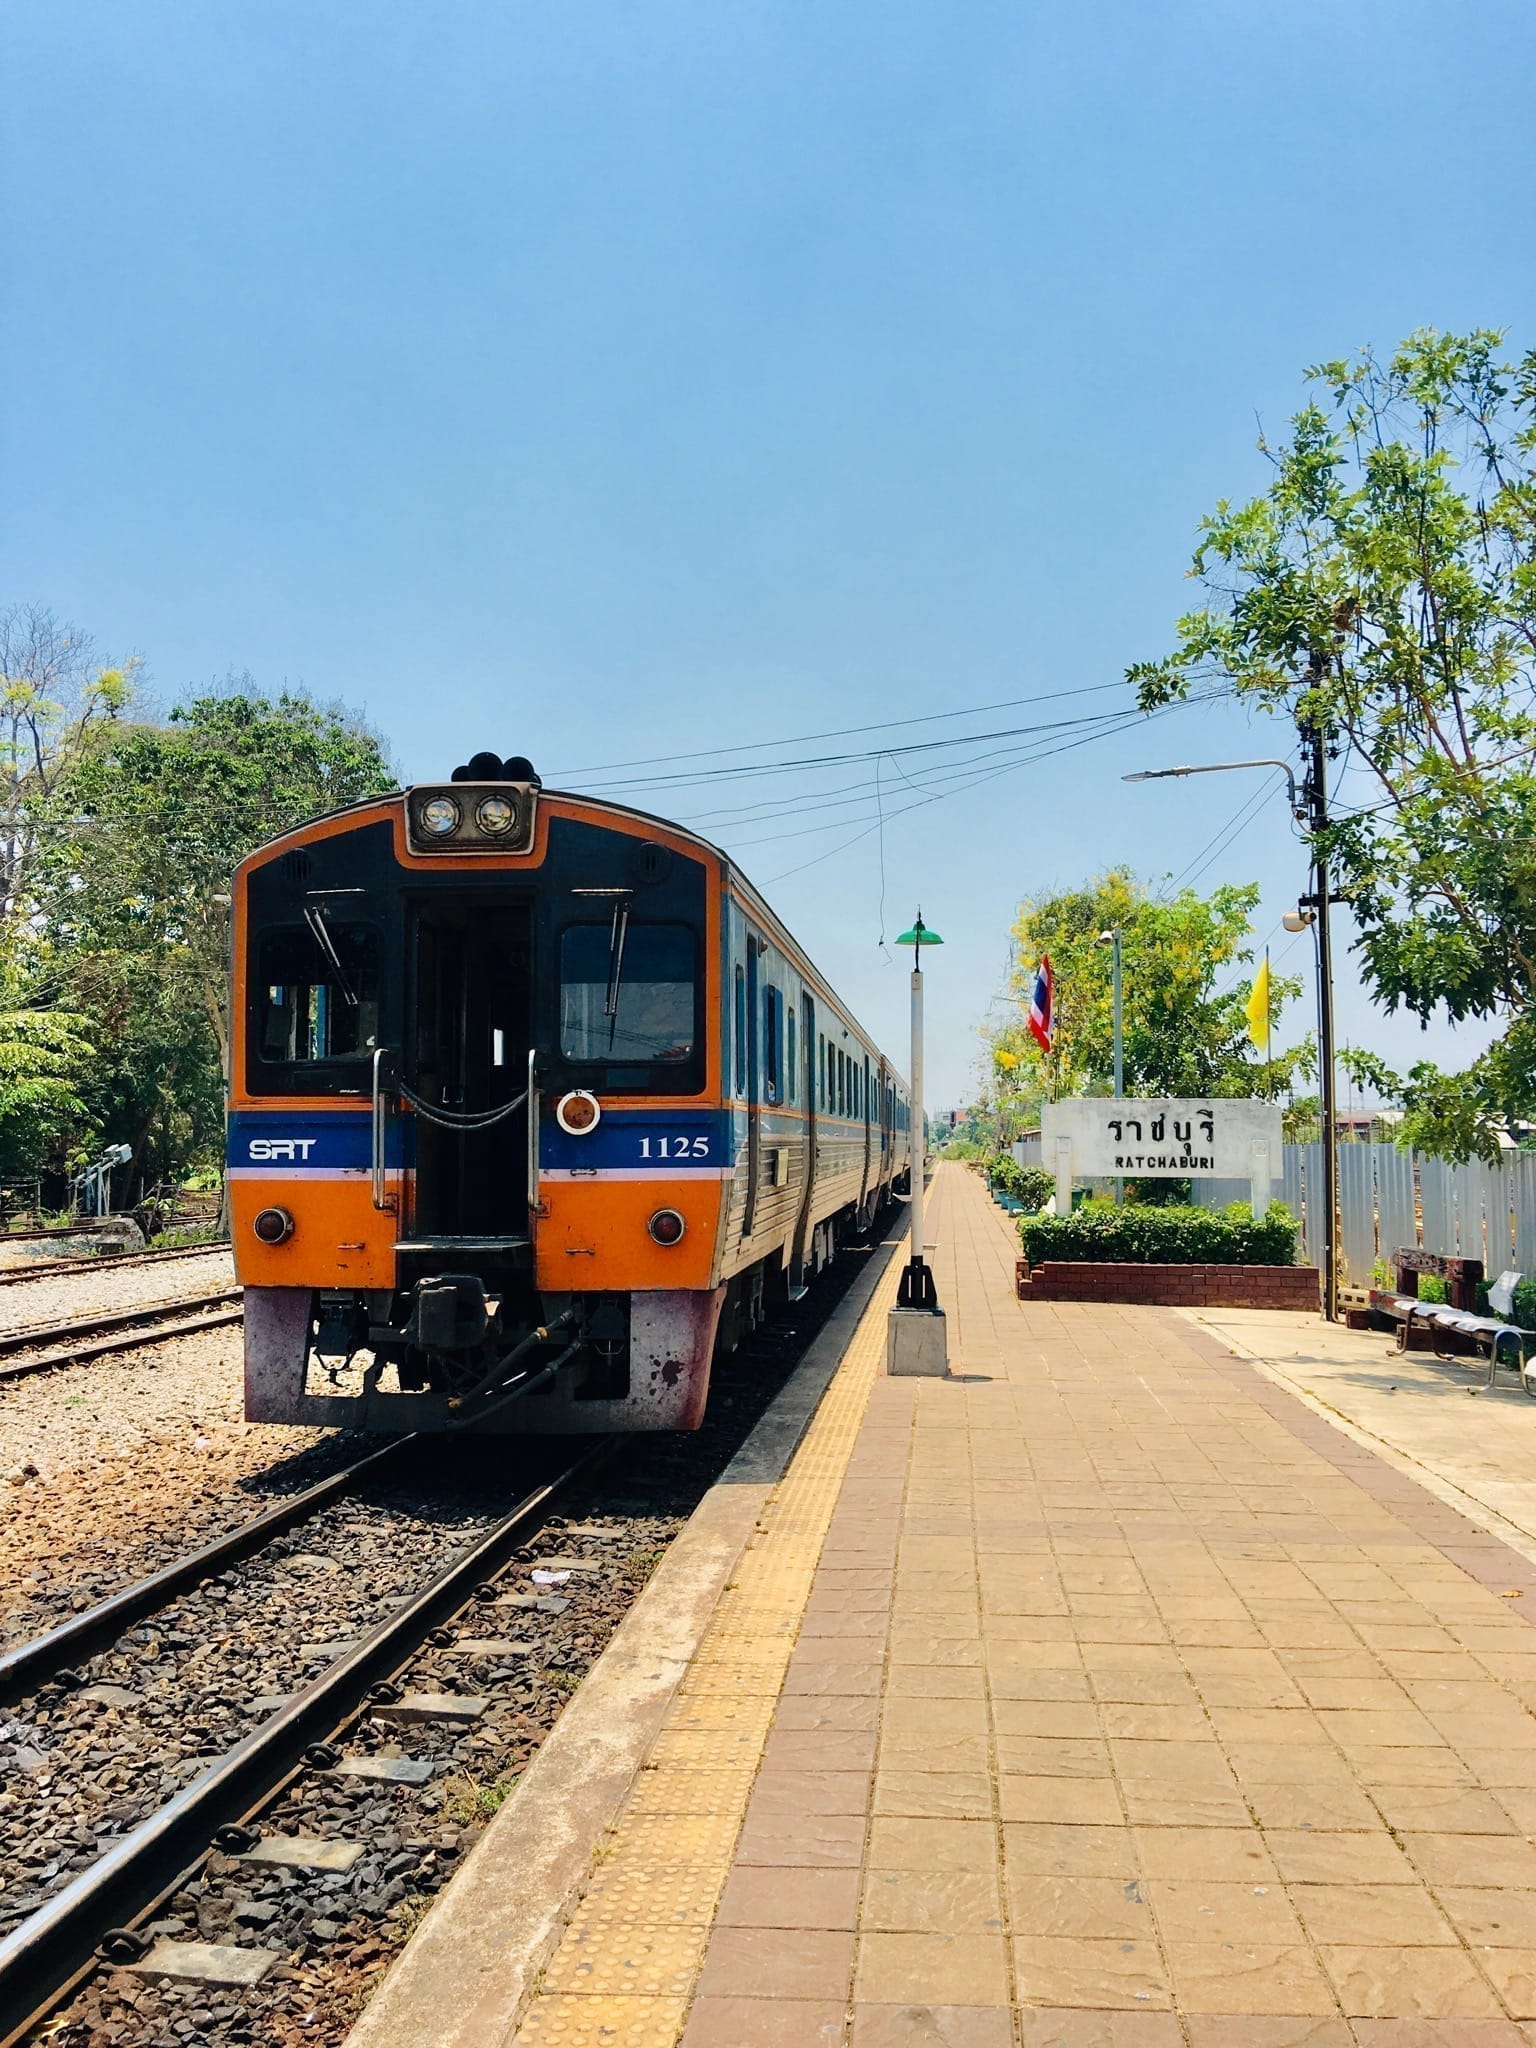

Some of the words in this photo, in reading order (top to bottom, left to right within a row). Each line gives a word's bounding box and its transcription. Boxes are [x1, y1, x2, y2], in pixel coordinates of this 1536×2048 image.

[1108, 1109, 1214, 1156] ราชบุรี
[249, 1139, 317, 1160] SRT
[639, 1136, 709, 1158] 1125
[1115, 1156, 1214, 1169] RATCHABURI
